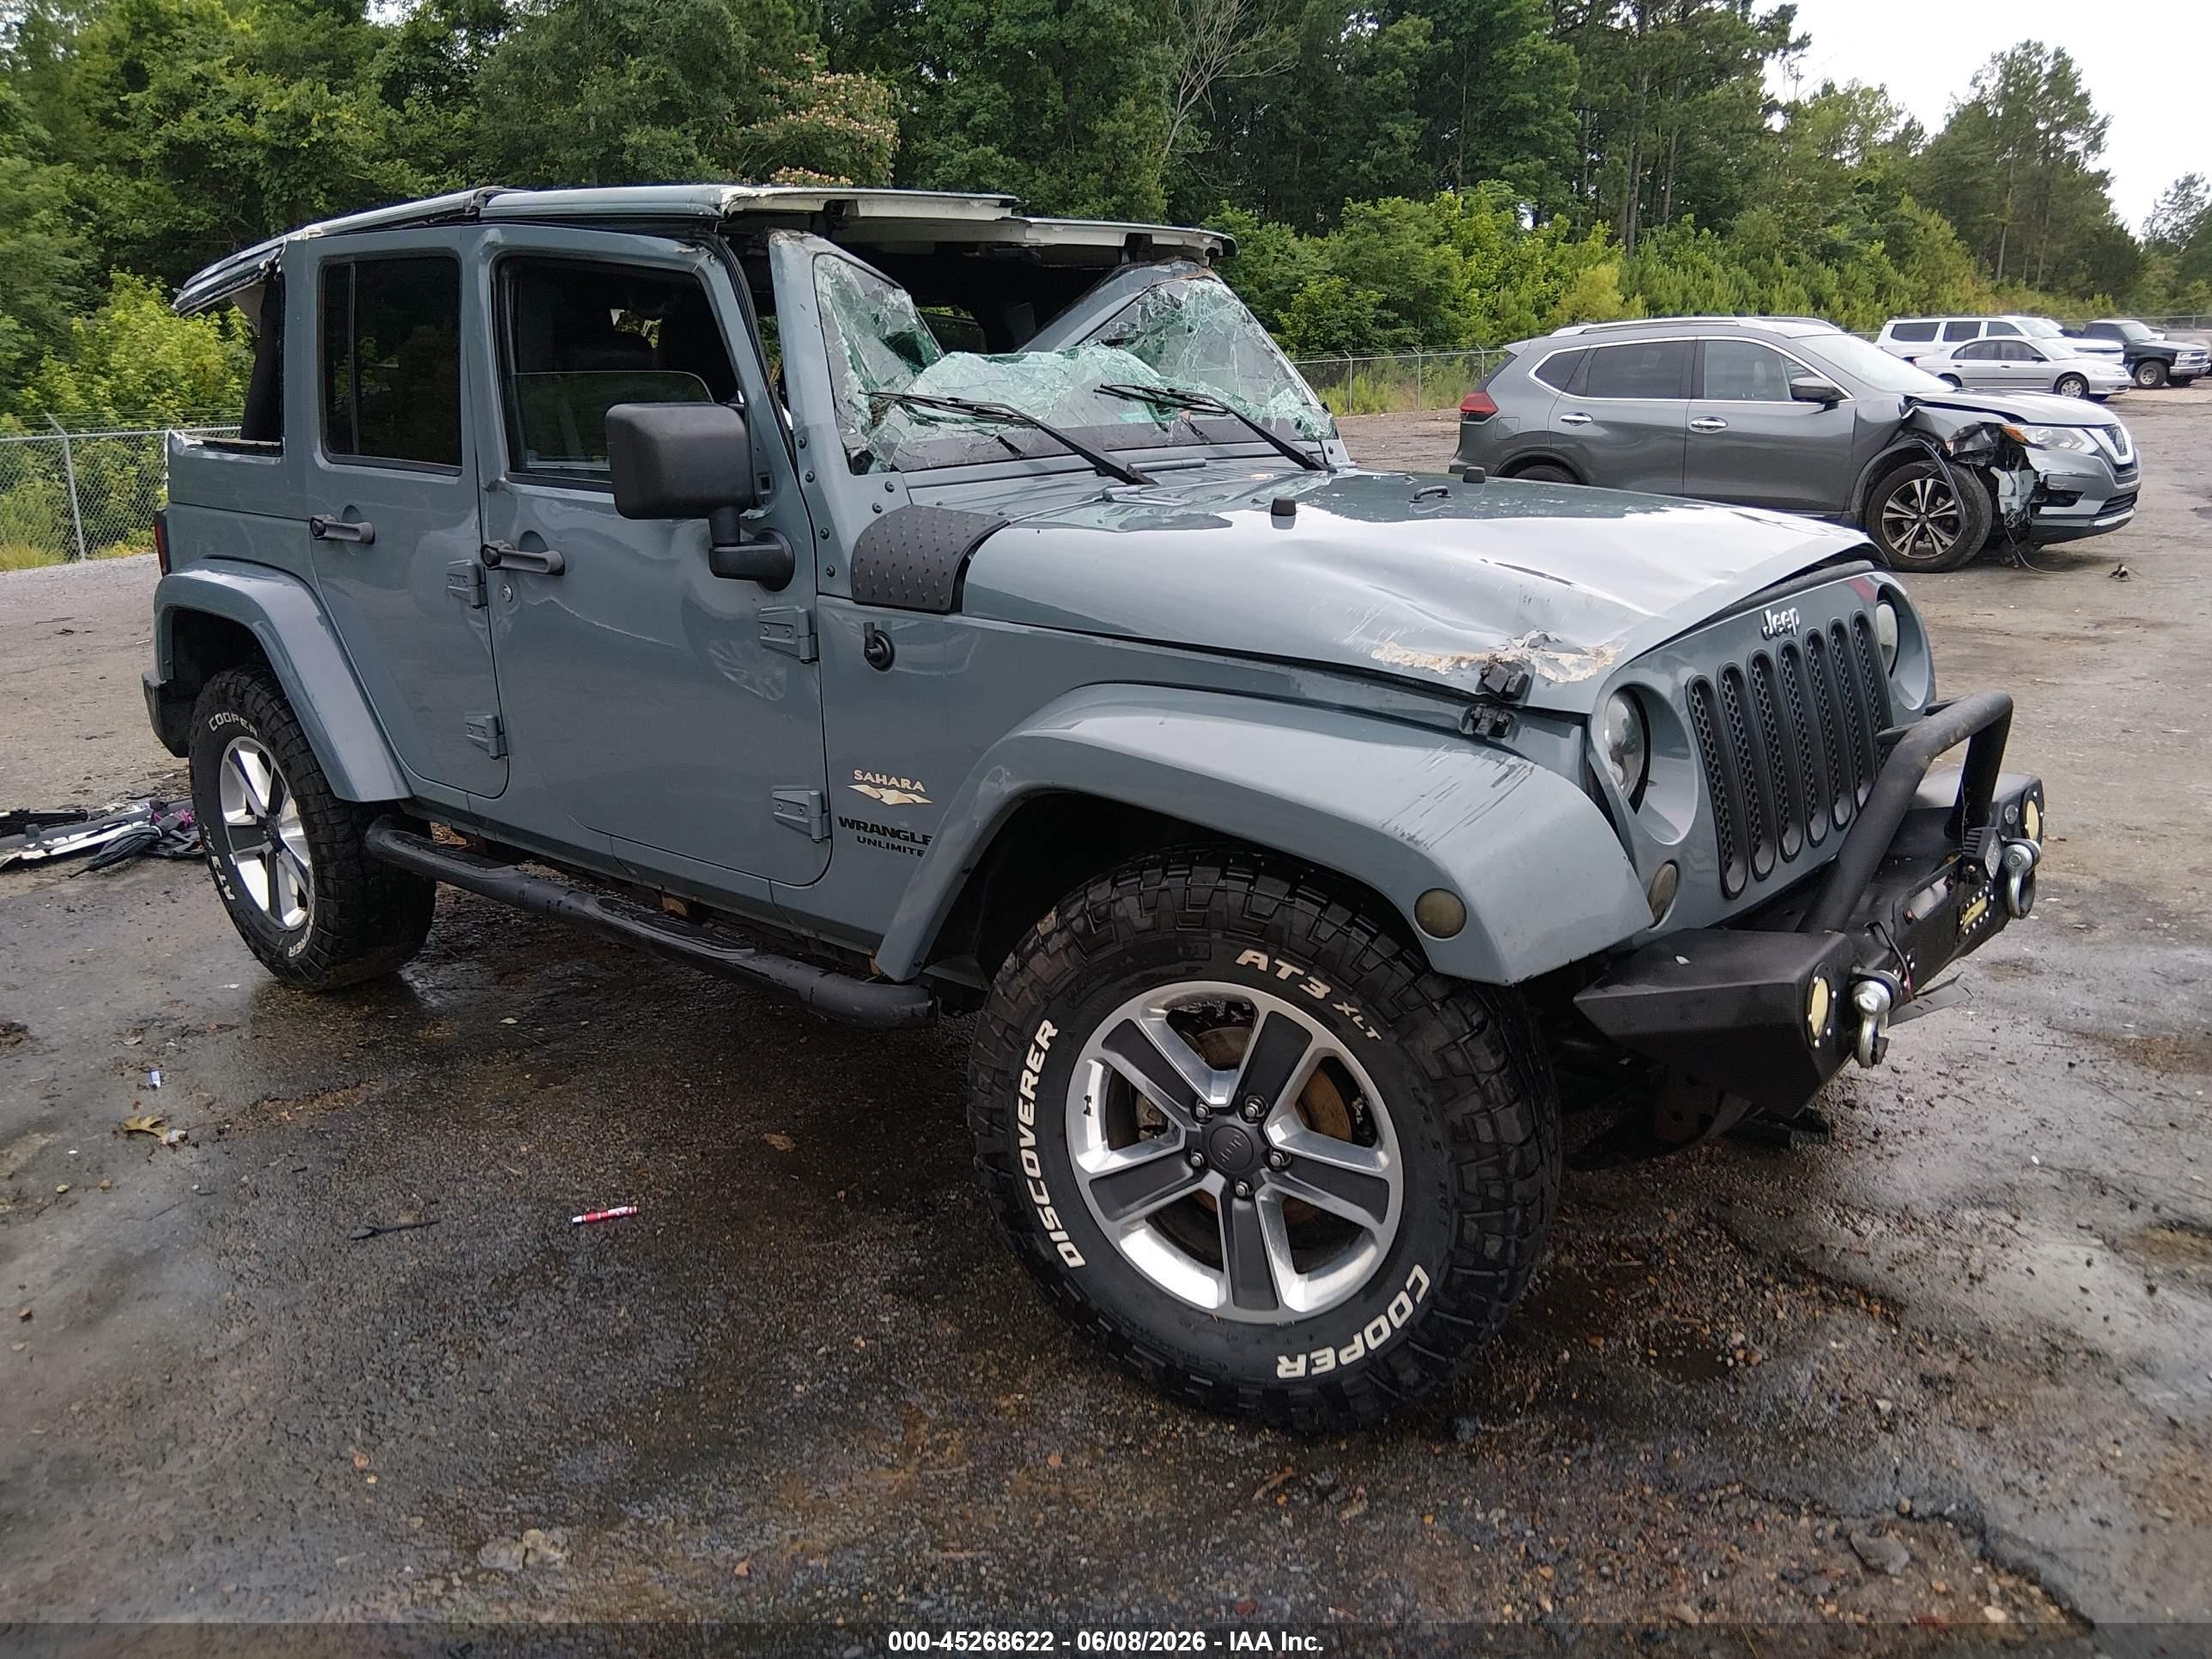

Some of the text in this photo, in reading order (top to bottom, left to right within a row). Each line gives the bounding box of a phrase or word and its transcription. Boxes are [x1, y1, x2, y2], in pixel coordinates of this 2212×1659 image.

[1761, 606, 1800, 641] Jeep
[209, 712, 258, 738] COOPER
[853, 769, 926, 793] SAHARA
[1235, 948, 1332, 1000] AT3
[1332, 1000, 1382, 1040] XLT
[1018, 1019, 1086, 1269] DISCOVERER
[1276, 1263, 1431, 1379] COOPER
